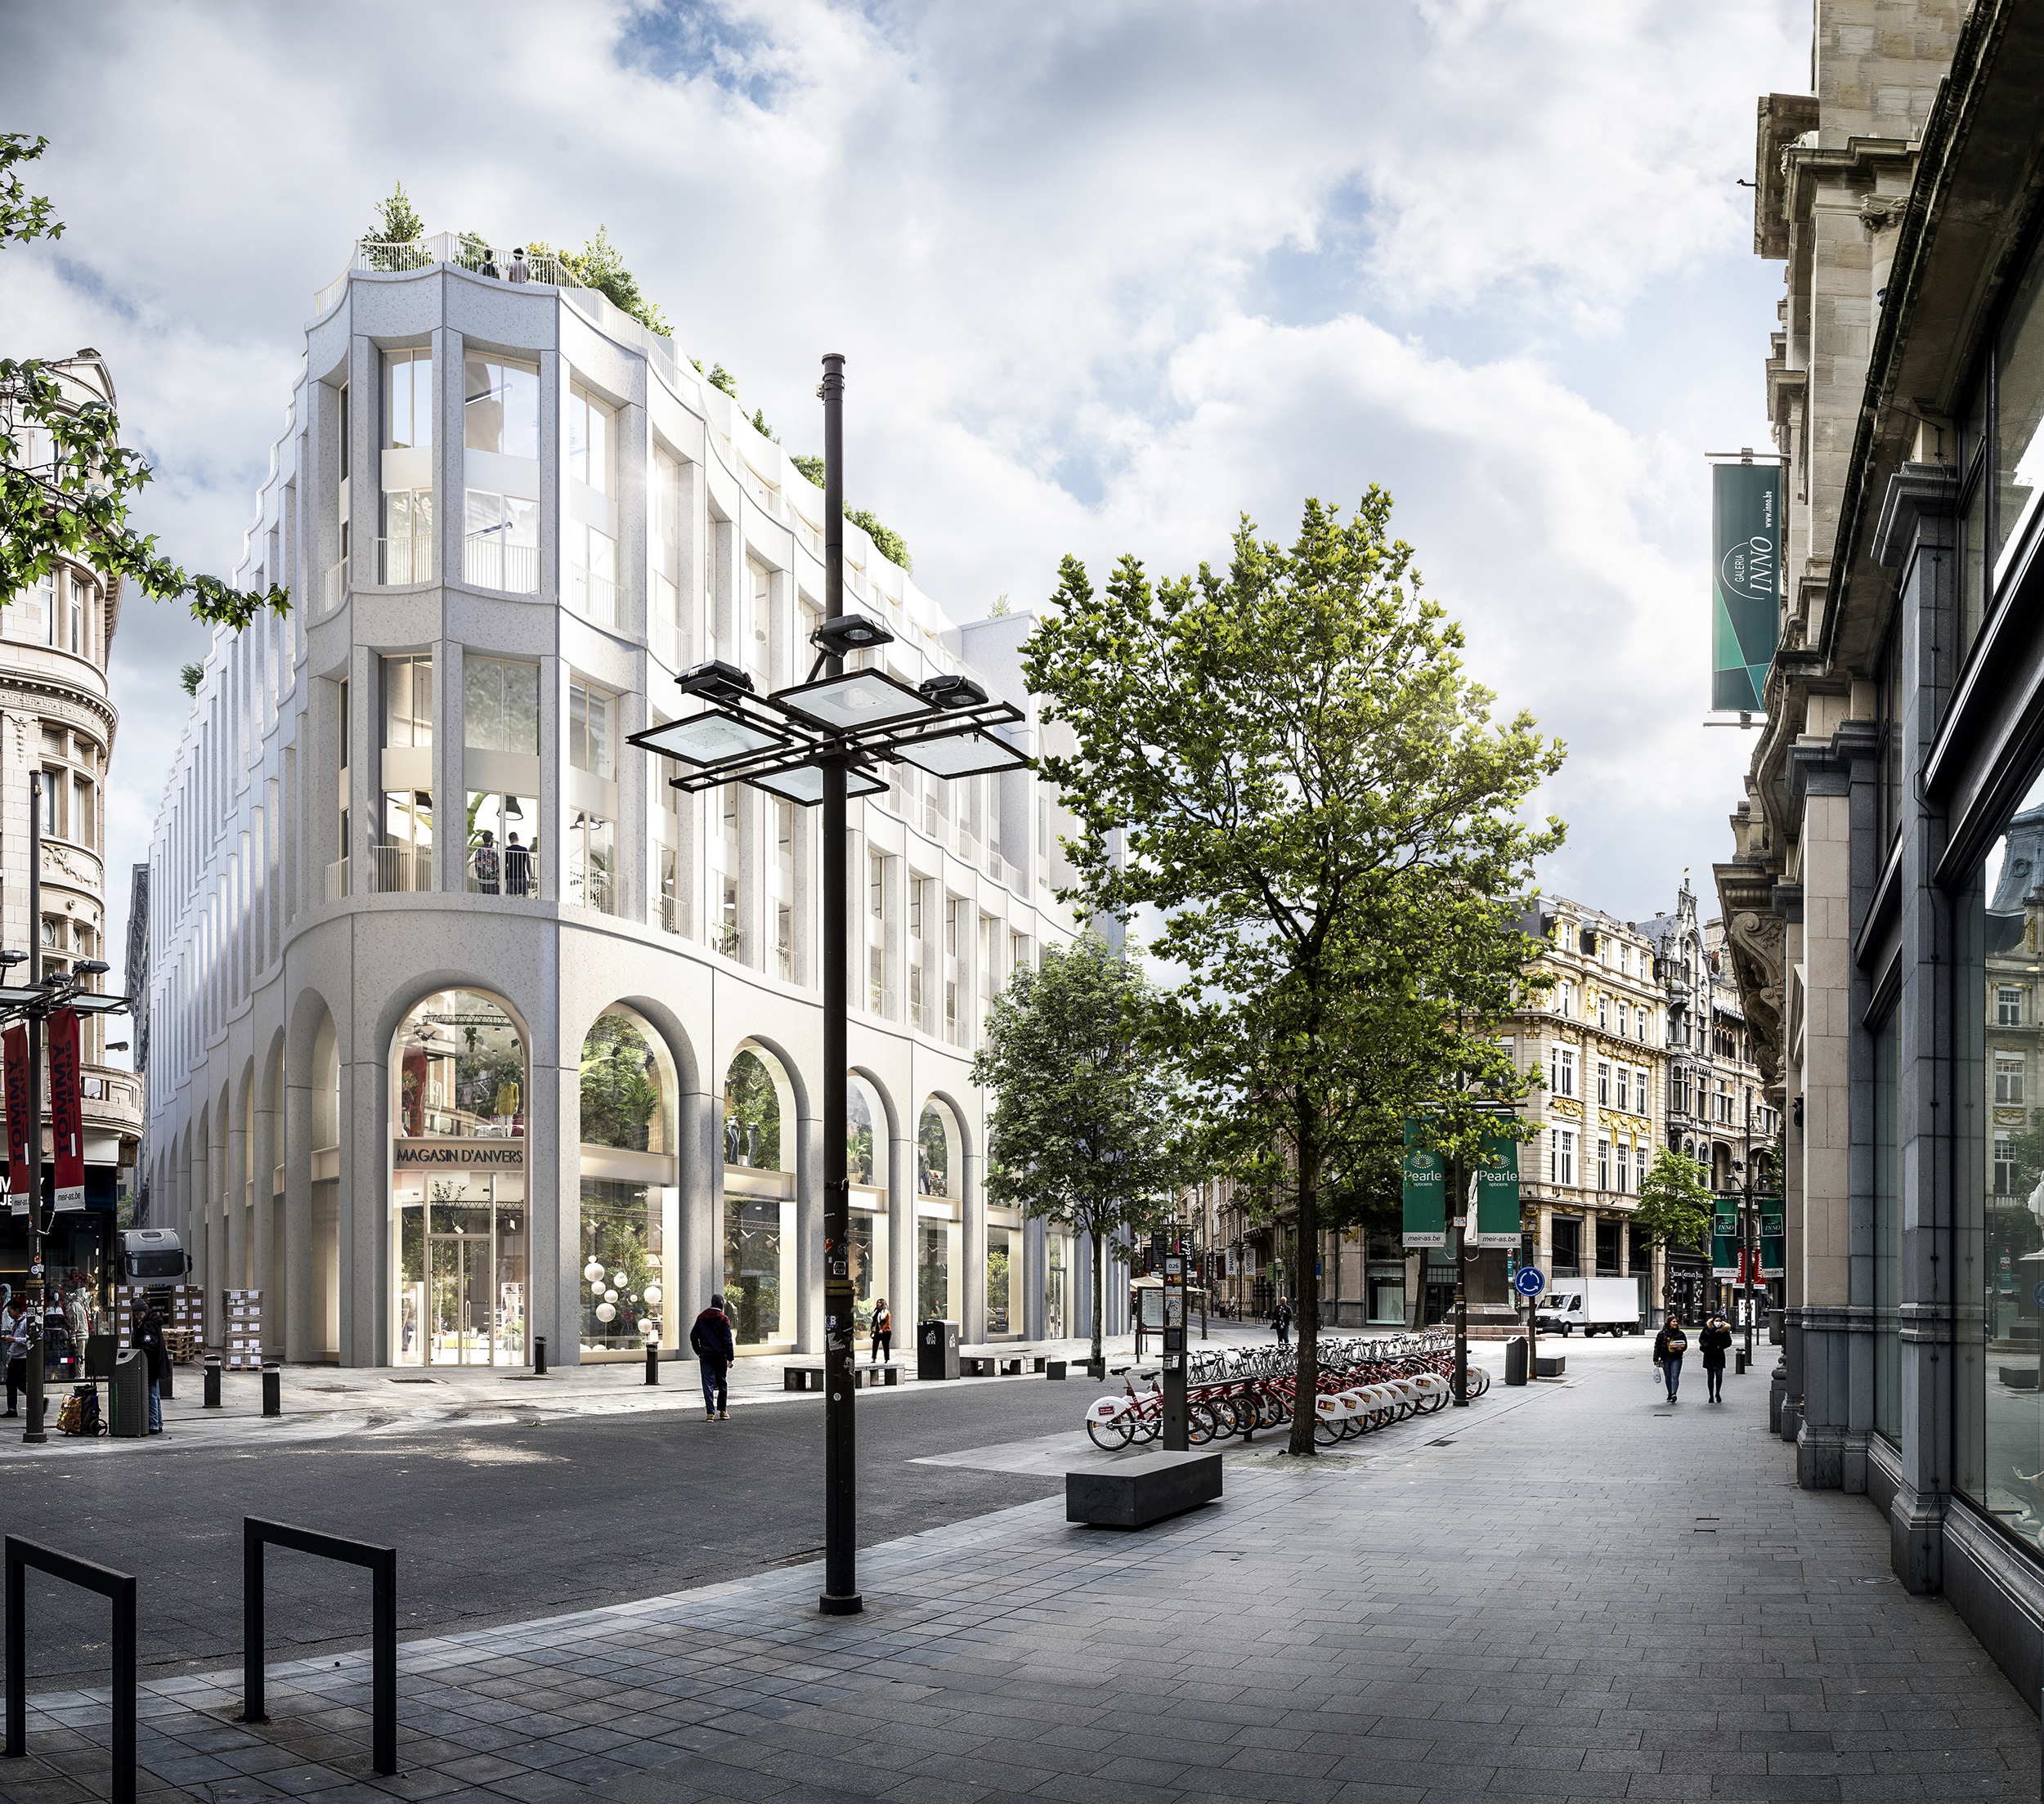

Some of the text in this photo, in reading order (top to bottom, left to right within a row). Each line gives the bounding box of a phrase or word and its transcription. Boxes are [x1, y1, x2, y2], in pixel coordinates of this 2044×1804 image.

[1762, 490, 1773, 528] www.inno.be
[1734, 554, 1745, 583] GALERIA
[1750, 535, 1773, 593] INNO
[17, 1055, 28, 1121] JEANS
[65, 1039, 75, 1108] JEANS
[7, 1058, 23, 1167] TOMMY
[52, 1043, 69, 1159] TOMMY
[396, 1148, 523, 1163] MAGASIN D'ANVERS
[1404, 1170, 1442, 1182] Pearle
[1479, 1170, 1517, 1182] Pearle
[14, 1197, 29, 1206] meir-as.
[56, 1191, 81, 1202] meir-as.be
